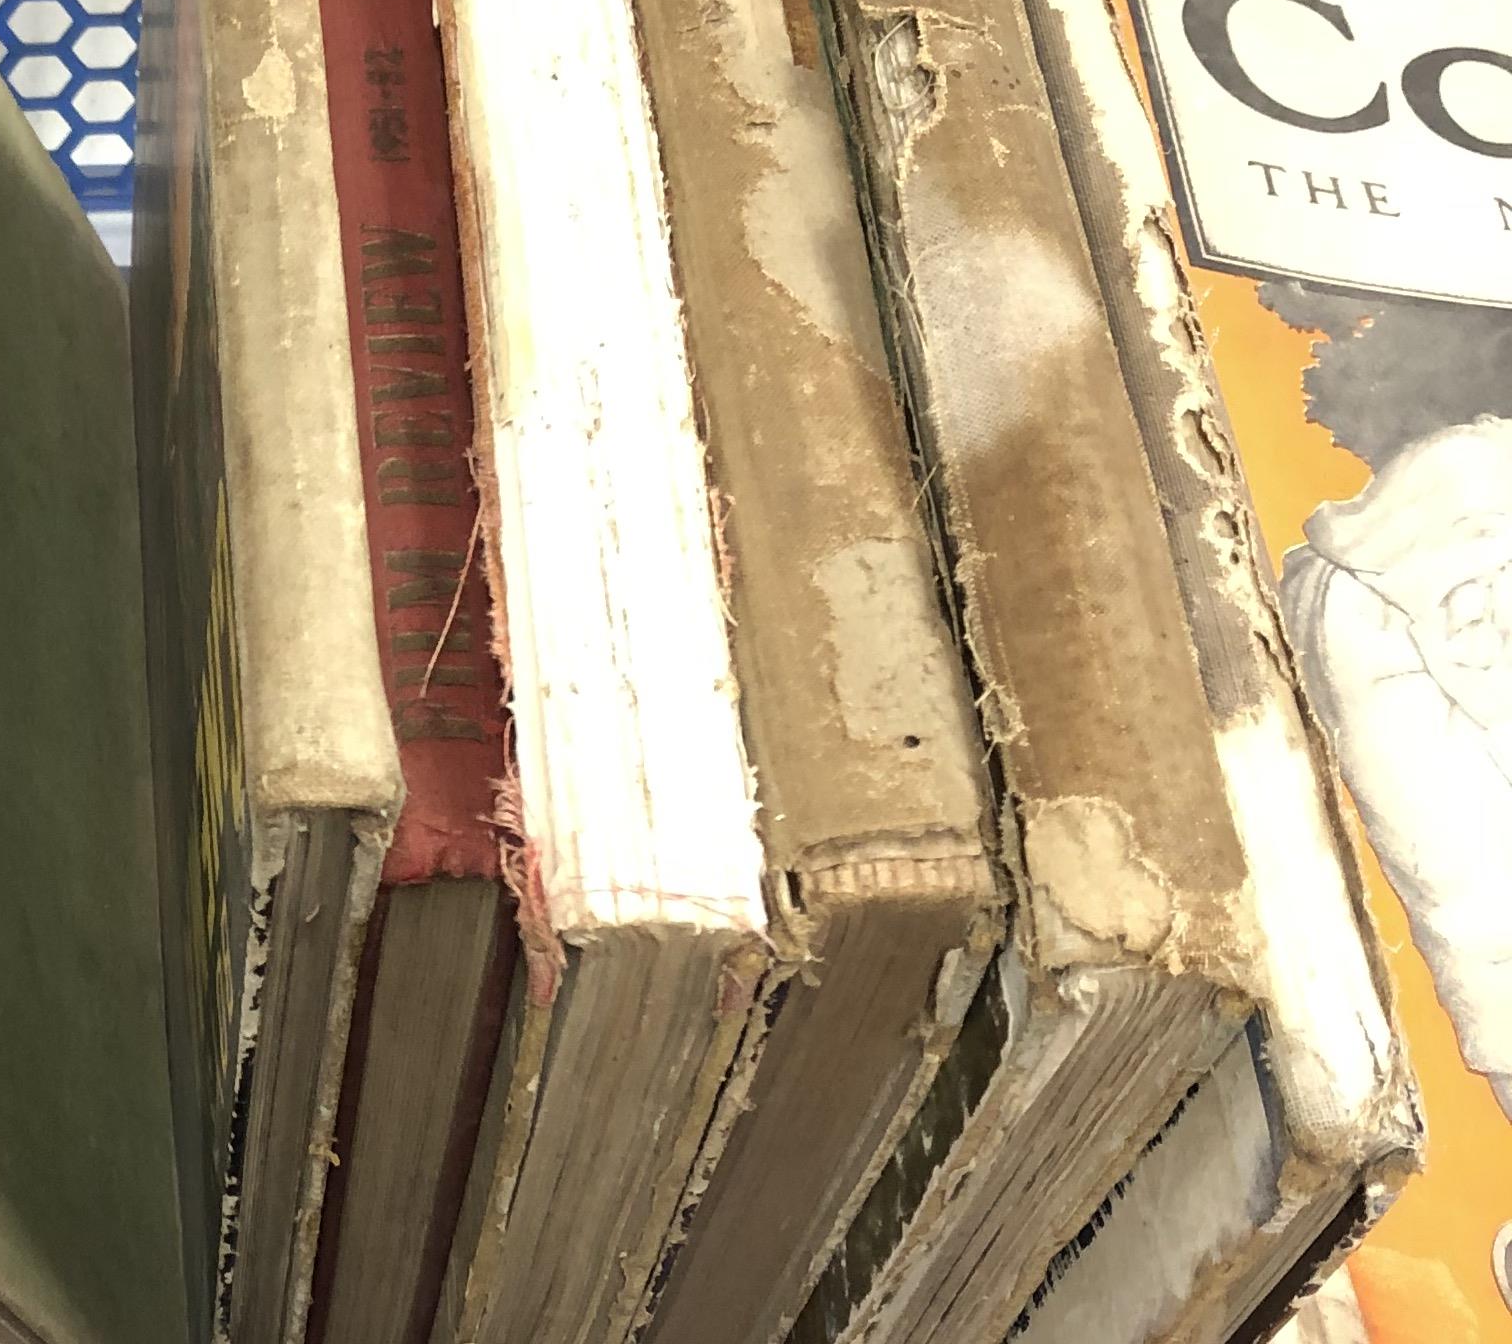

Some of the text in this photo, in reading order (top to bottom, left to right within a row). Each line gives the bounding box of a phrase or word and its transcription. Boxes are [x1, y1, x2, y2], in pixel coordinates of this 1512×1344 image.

[1248, 160, 1400, 217] THE
[360, 223, 486, 744] FILM REVIEW
